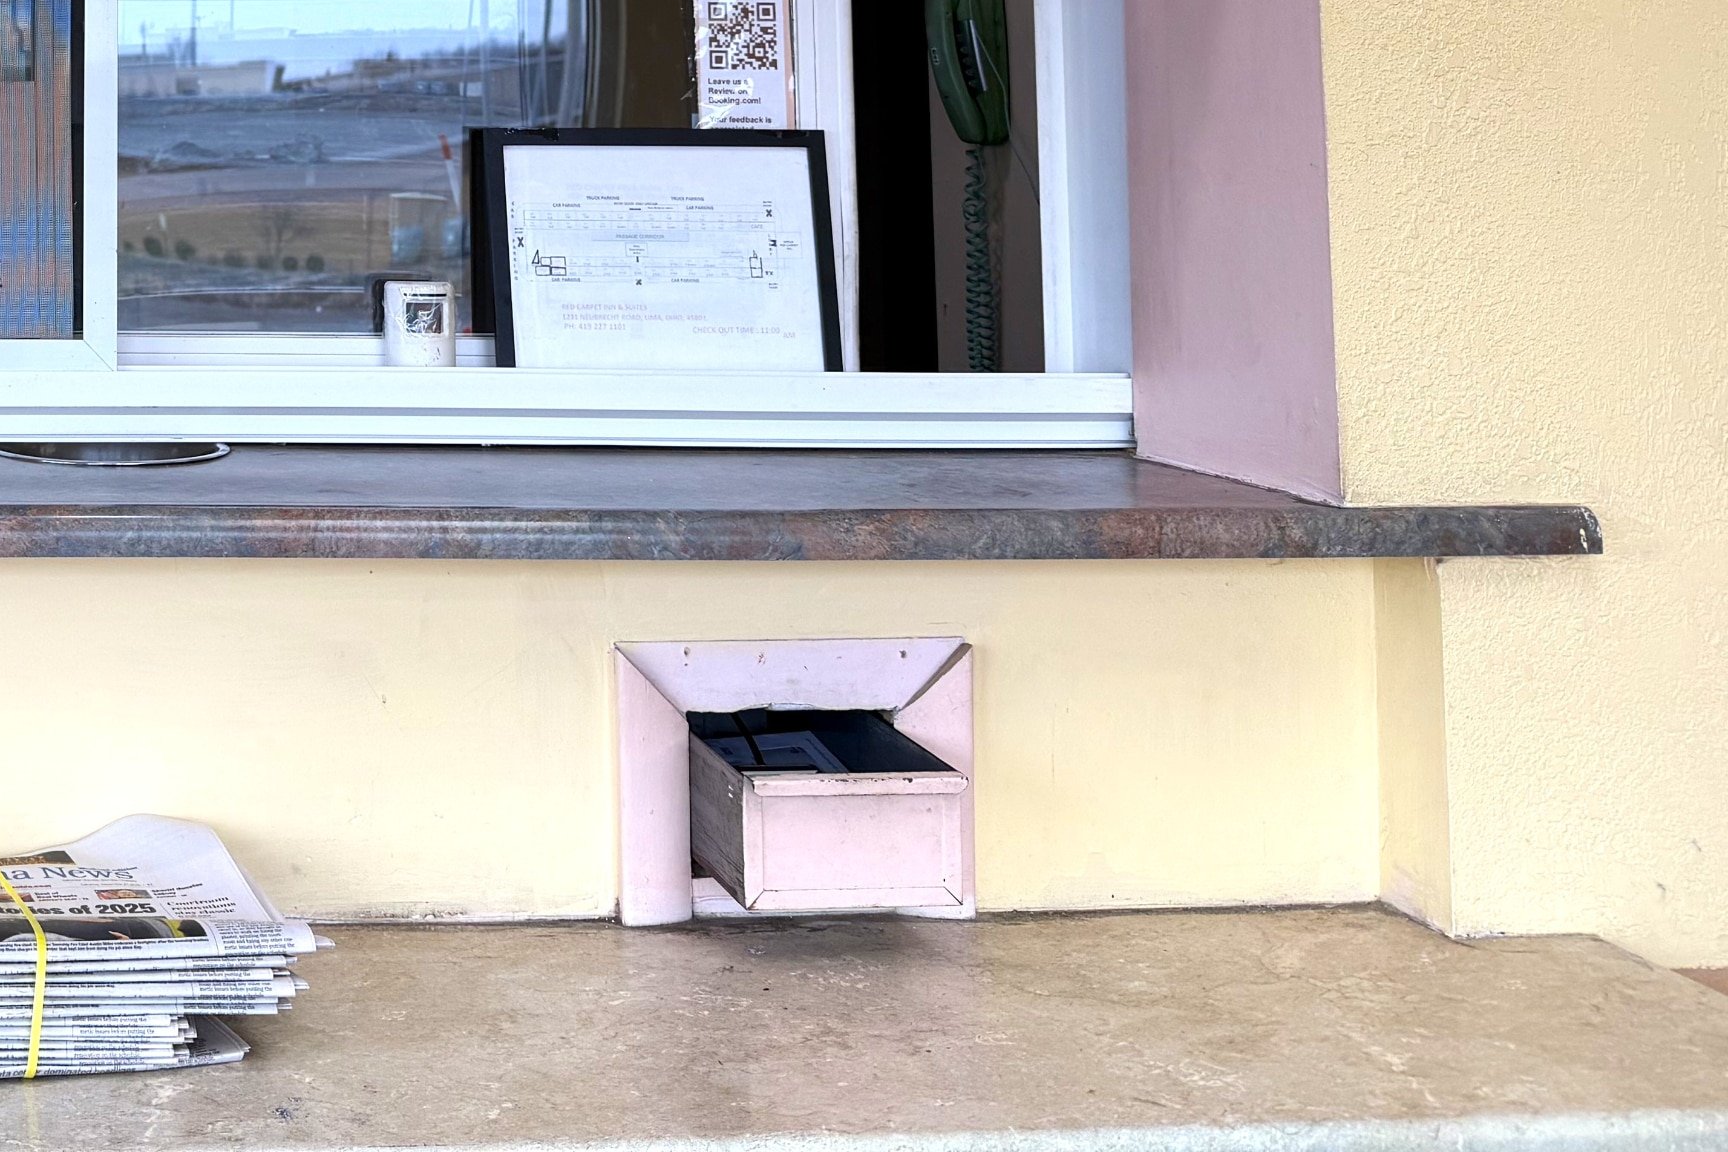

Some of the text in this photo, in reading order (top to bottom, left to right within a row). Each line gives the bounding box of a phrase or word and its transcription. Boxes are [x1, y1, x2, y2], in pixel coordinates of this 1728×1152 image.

[41, 866, 134, 880] News
[69, 903, 91, 914] of
[94, 902, 157, 915] 2025
[43, 1067, 91, 1075] dominated
